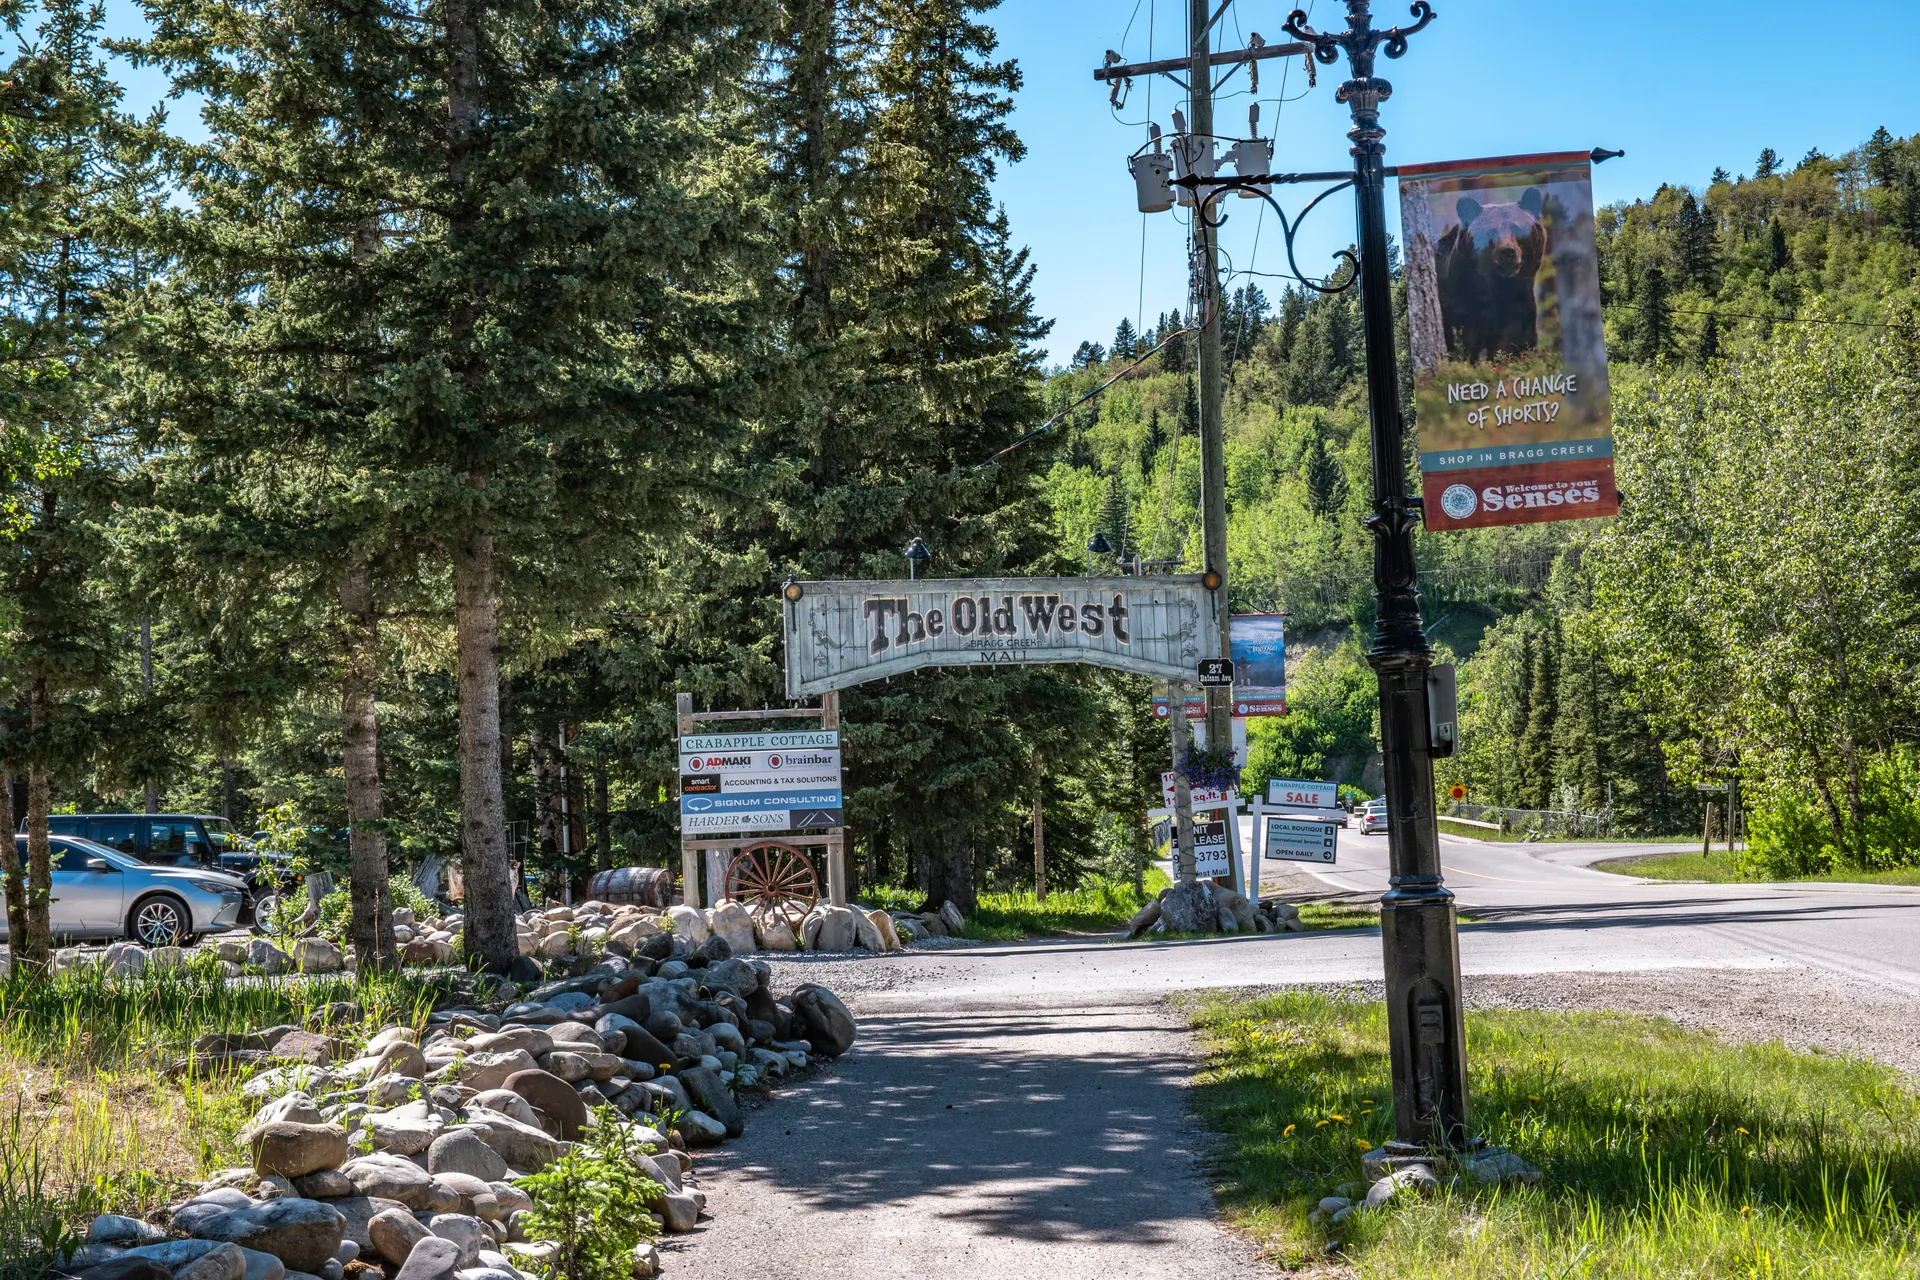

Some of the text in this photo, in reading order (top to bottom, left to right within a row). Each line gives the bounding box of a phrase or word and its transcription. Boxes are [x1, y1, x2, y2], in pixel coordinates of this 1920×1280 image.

[1448, 373, 1577, 404] NEED A CHANGE
[1467, 401, 1559, 429] OF SHORTS?
[1439, 445, 1594, 465] SHOP IN BRAGG CREEK
[1505, 480, 1598, 494] Welcome to your
[1482, 486, 1600, 512] Senses
[862, 592, 1131, 657] The Old West
[970, 638, 1037, 648] BRAGG CREEK
[980, 650, 1034, 663] MALL
[1208, 663, 1223, 674] 27
[685, 734, 833, 750] CRABAPPLE COTTAGE
[706, 756, 751, 767] ADMAKI
[785, 754, 833, 765] brainbar
[691, 777, 710, 786] smart
[724, 777, 772, 787] ACCOUNTING
[773, 777, 779, 785] &
[796, 775, 837, 784] SOLUTIONS
[1271, 781, 1306, 789] CRABAPPLE
[684, 784, 717, 792] contractor
[714, 795, 836, 807] SIGNUM CONSULTING
[1194, 791, 1220, 802] sq.ft.
[1286, 792, 1319, 804] SALE
[688, 813, 784, 827] HARDER SONS
[1193, 824, 1208, 835] NIT
[1271, 823, 1323, 833] LOCAL BOUTIQUE
[1194, 834, 1225, 846] LEASE
[1211, 868, 1228, 876] Mall
